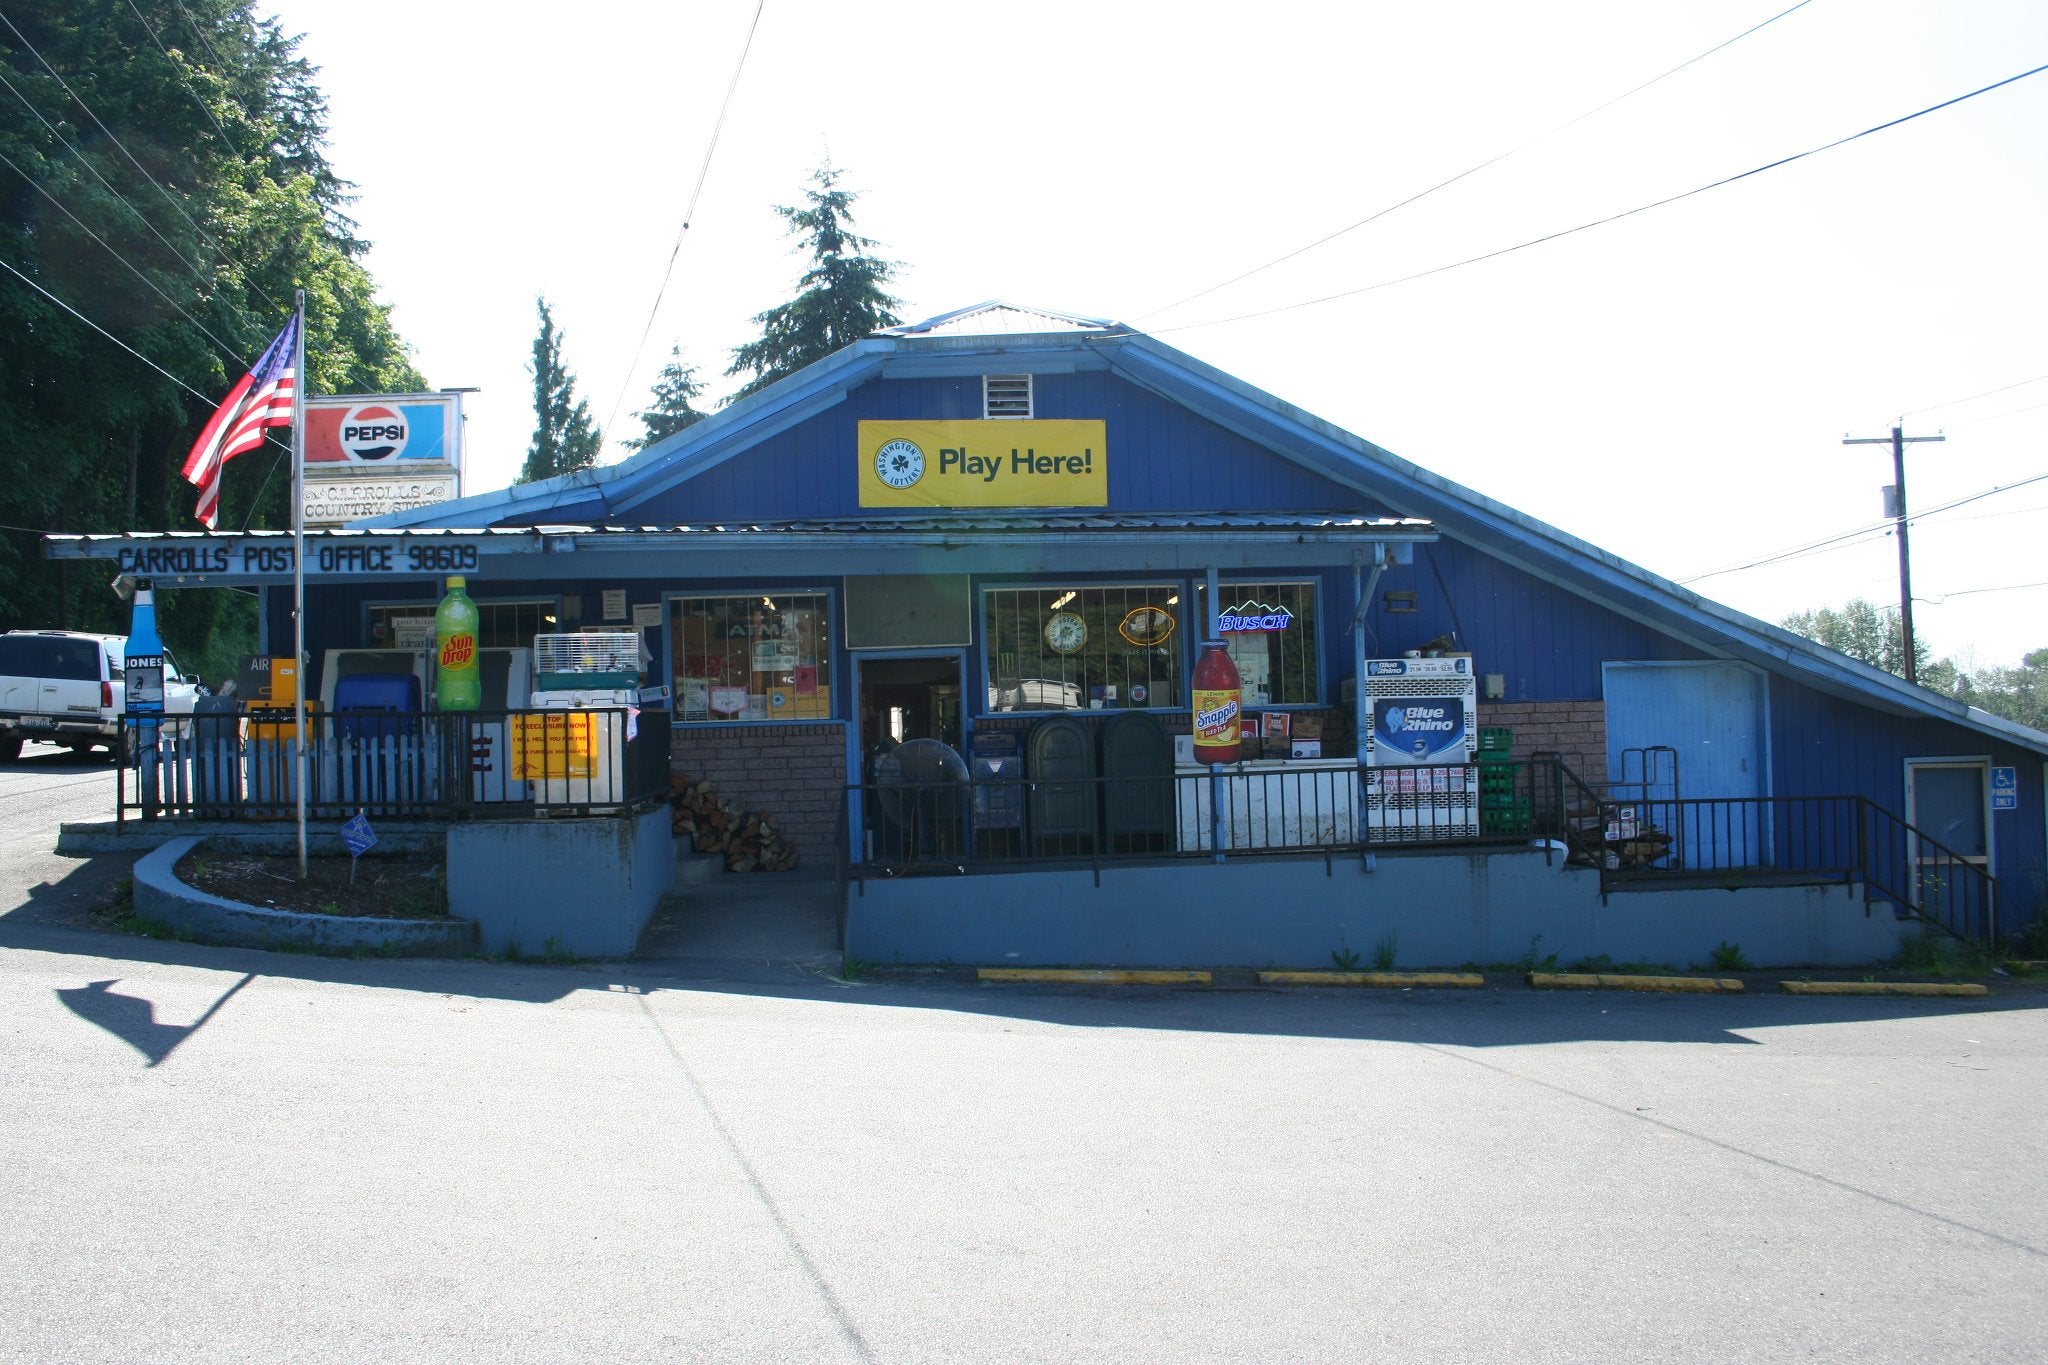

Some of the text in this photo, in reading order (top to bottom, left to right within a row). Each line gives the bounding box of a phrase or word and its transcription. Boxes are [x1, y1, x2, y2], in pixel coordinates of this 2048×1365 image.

[345, 426, 404, 441] PEPSI
[878, 443, 921, 476] WASHINGTON'S
[939, 447, 1092, 482] Play Here!
[890, 468, 920, 485] LOTTERY
[327, 486, 421, 501] CARROLLS
[305, 503, 385, 517] COUNTRY
[118, 544, 478, 573] CARROLLS POST OFFICE 98609
[729, 624, 781, 636] ATM
[1219, 615, 1290, 631] BUSCH
[446, 635, 472, 651] Sun
[126, 658, 162, 668] JONES
[442, 648, 471, 665] Drop
[251, 659, 269, 670] AIR
[1197, 702, 1236, 727] Snapple
[1406, 707, 1444, 718] Blue
[1402, 719, 1453, 731] Rhino
[1992, 788, 2015, 797] PARKING
[1996, 798, 2012, 806] ONLY
